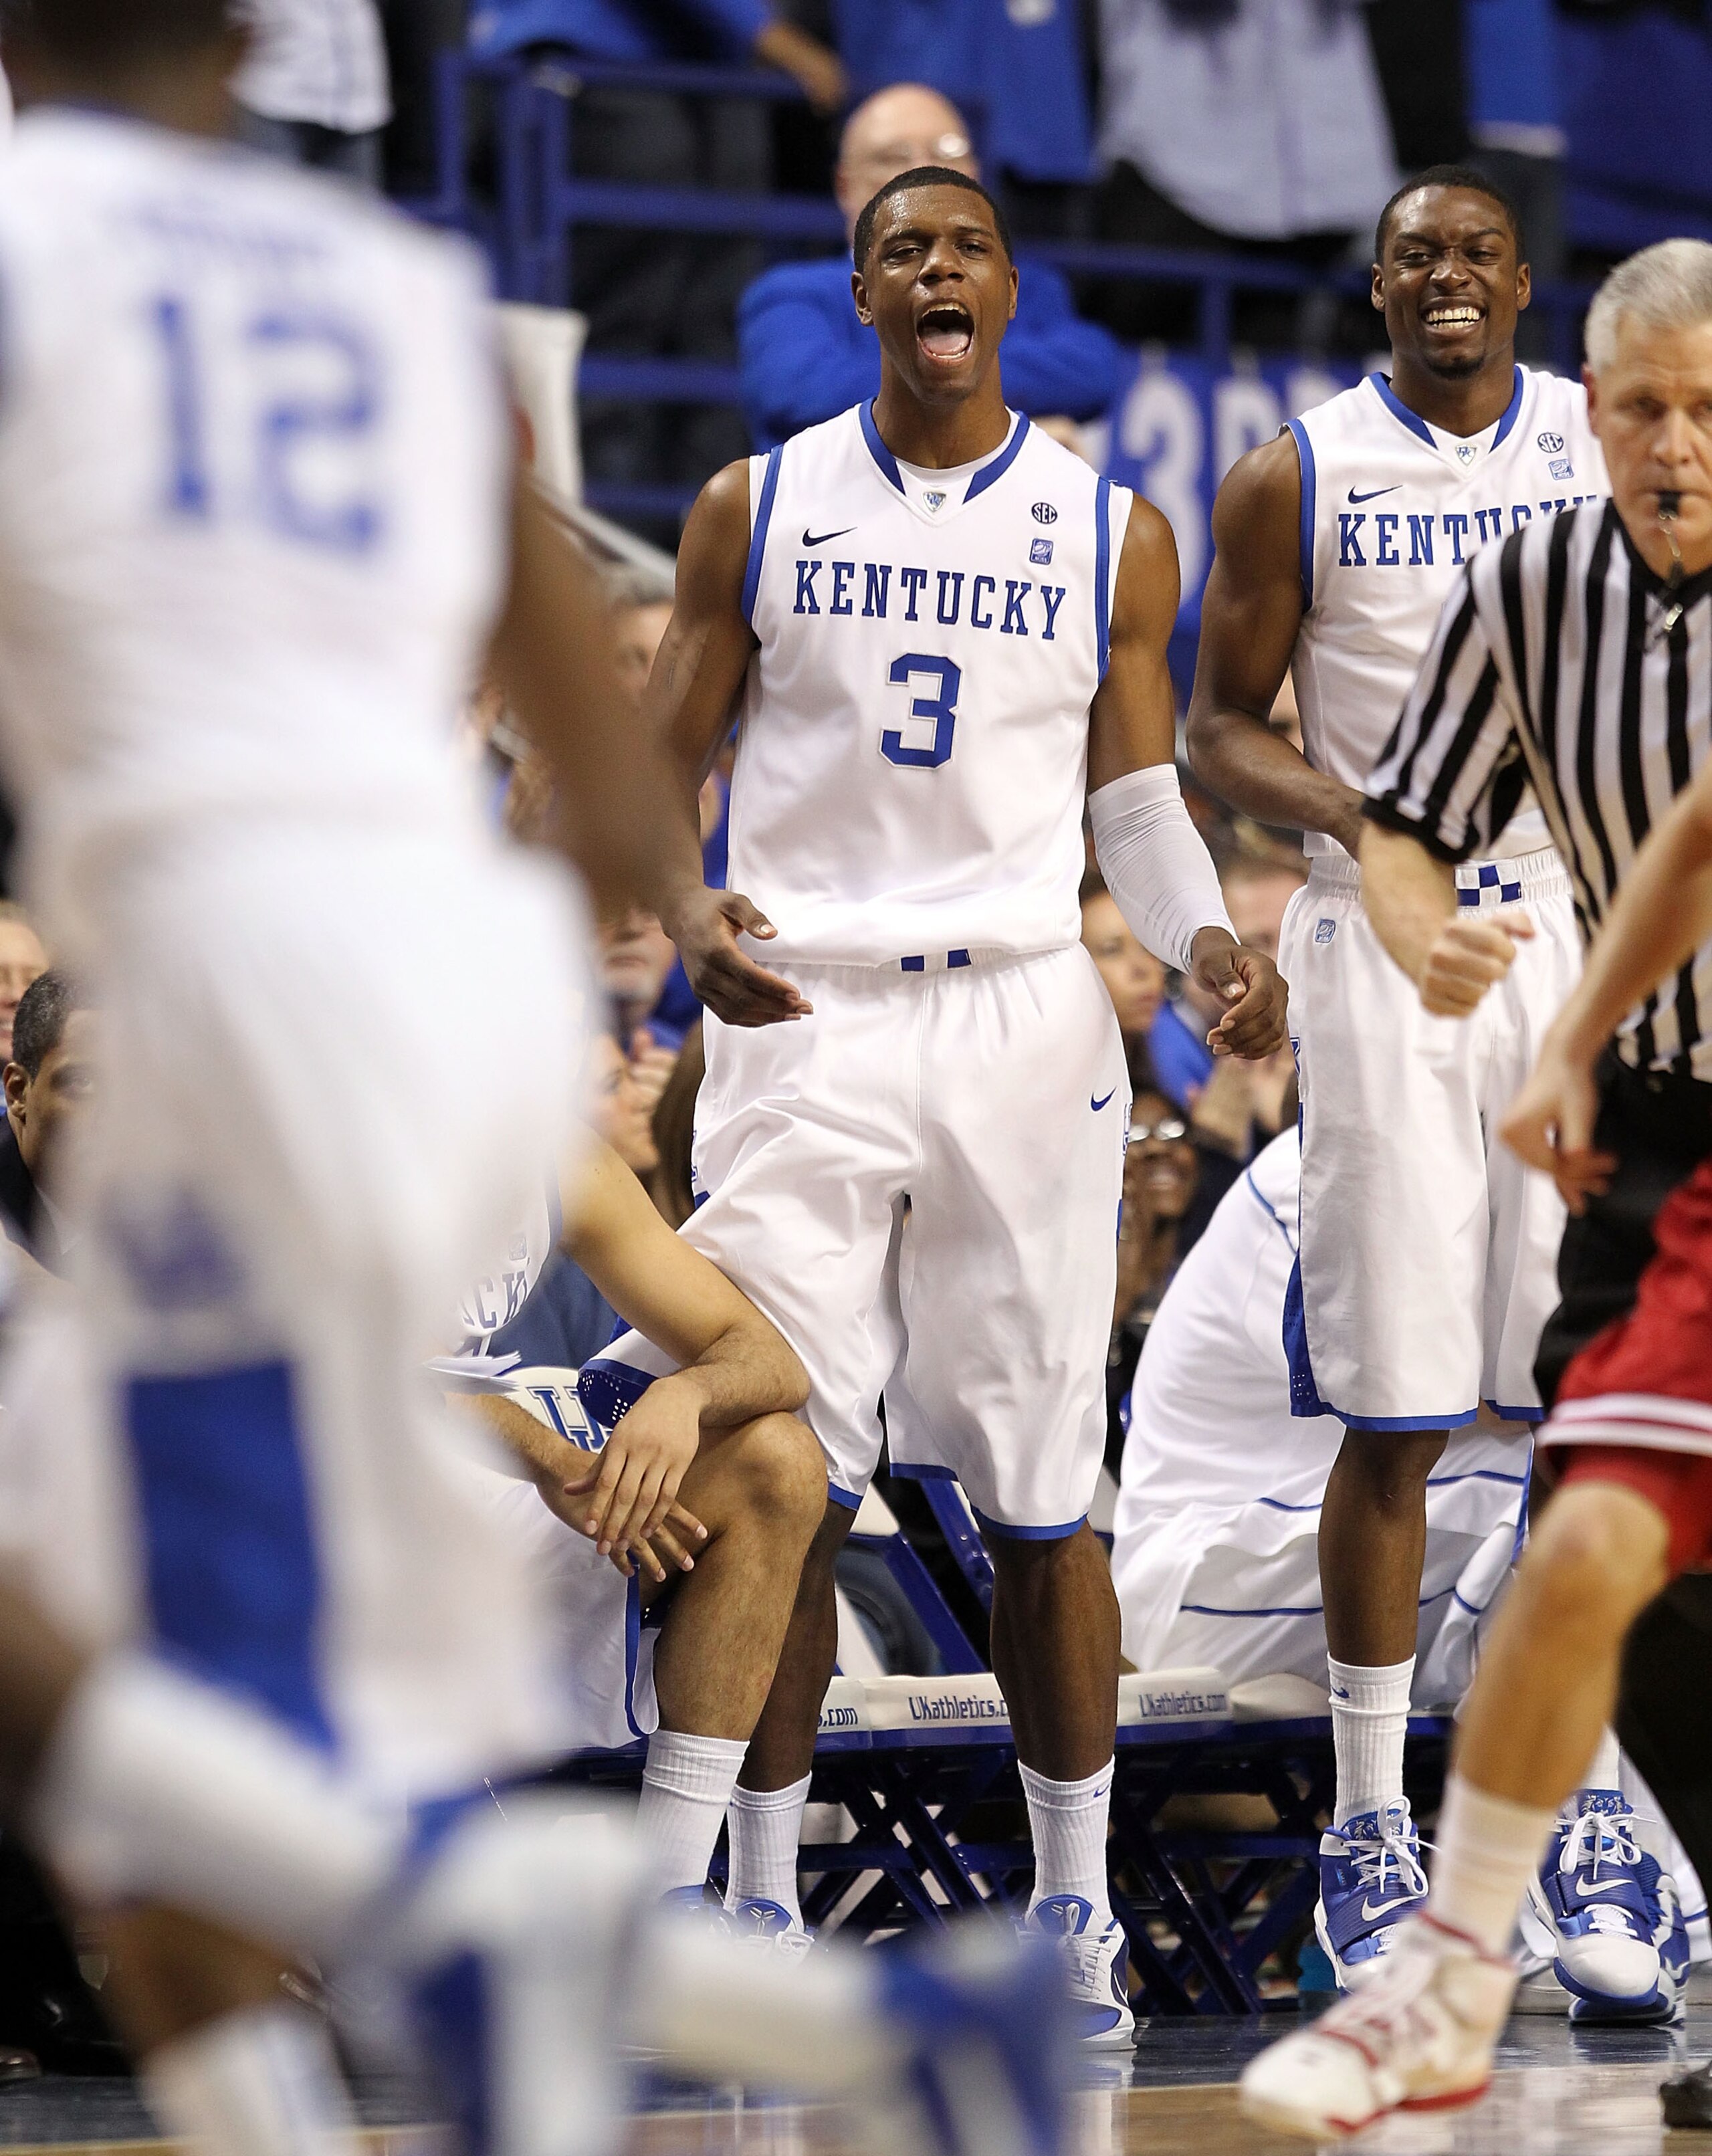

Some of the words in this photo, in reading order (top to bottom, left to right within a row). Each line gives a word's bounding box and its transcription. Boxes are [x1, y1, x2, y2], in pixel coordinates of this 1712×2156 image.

[151, 294, 385, 552] 12
[1538, 432, 1564, 453] SEC
[1031, 502, 1057, 524] SEC
[793, 560, 1065, 640] KENTUCKY
[879, 653, 962, 769] 3
